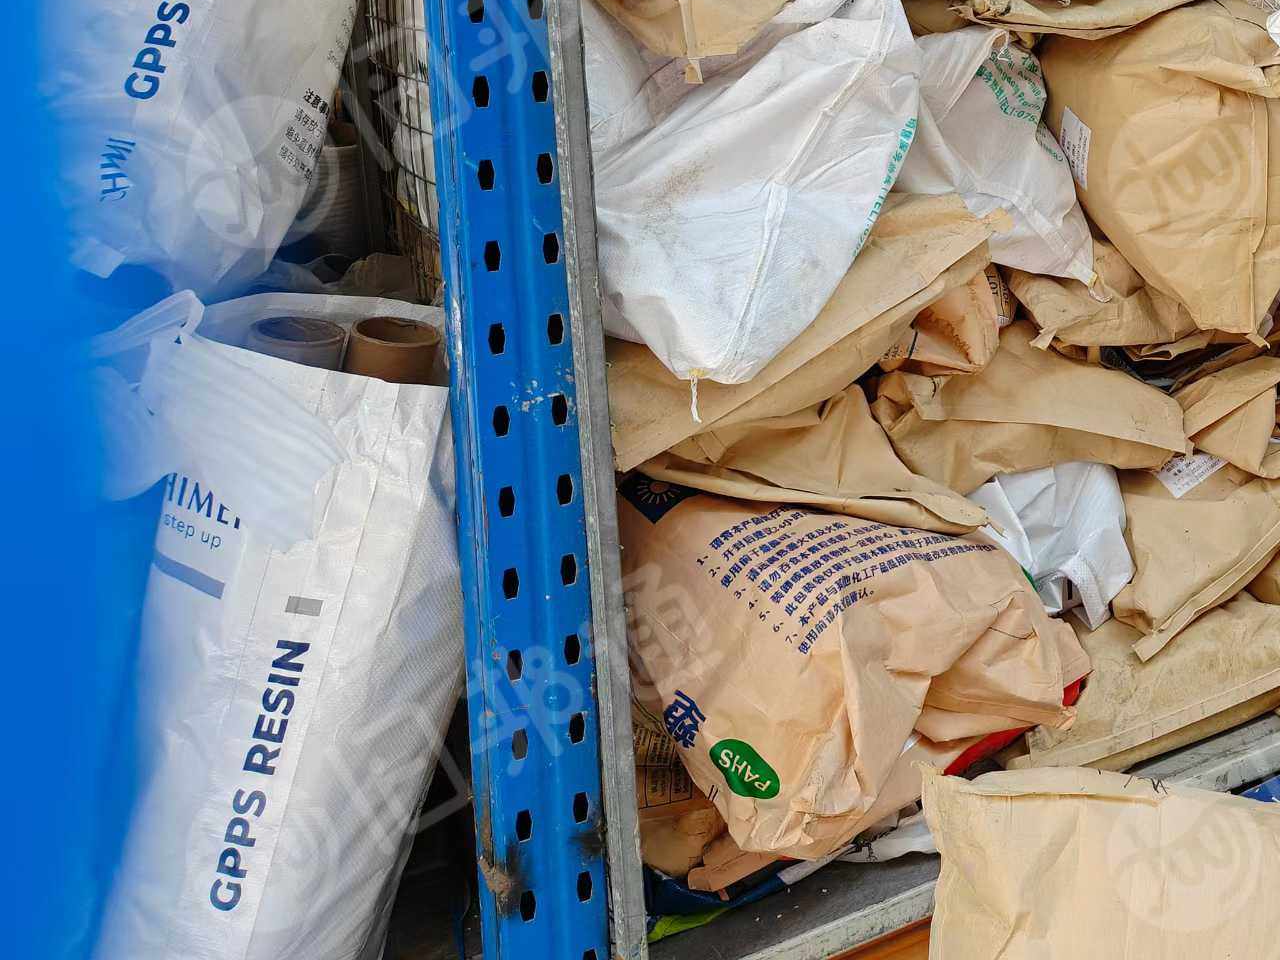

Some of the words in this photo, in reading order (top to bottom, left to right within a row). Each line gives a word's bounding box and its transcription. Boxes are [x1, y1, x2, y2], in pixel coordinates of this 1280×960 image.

[124, 1, 190, 101] GPPS
[163, 513, 195, 539] step
[200, 531, 222, 550] up
[209, 787, 268, 912] GPPS
[242, 639, 311, 777] RESIN
[719, 747, 772, 792] PAHS
